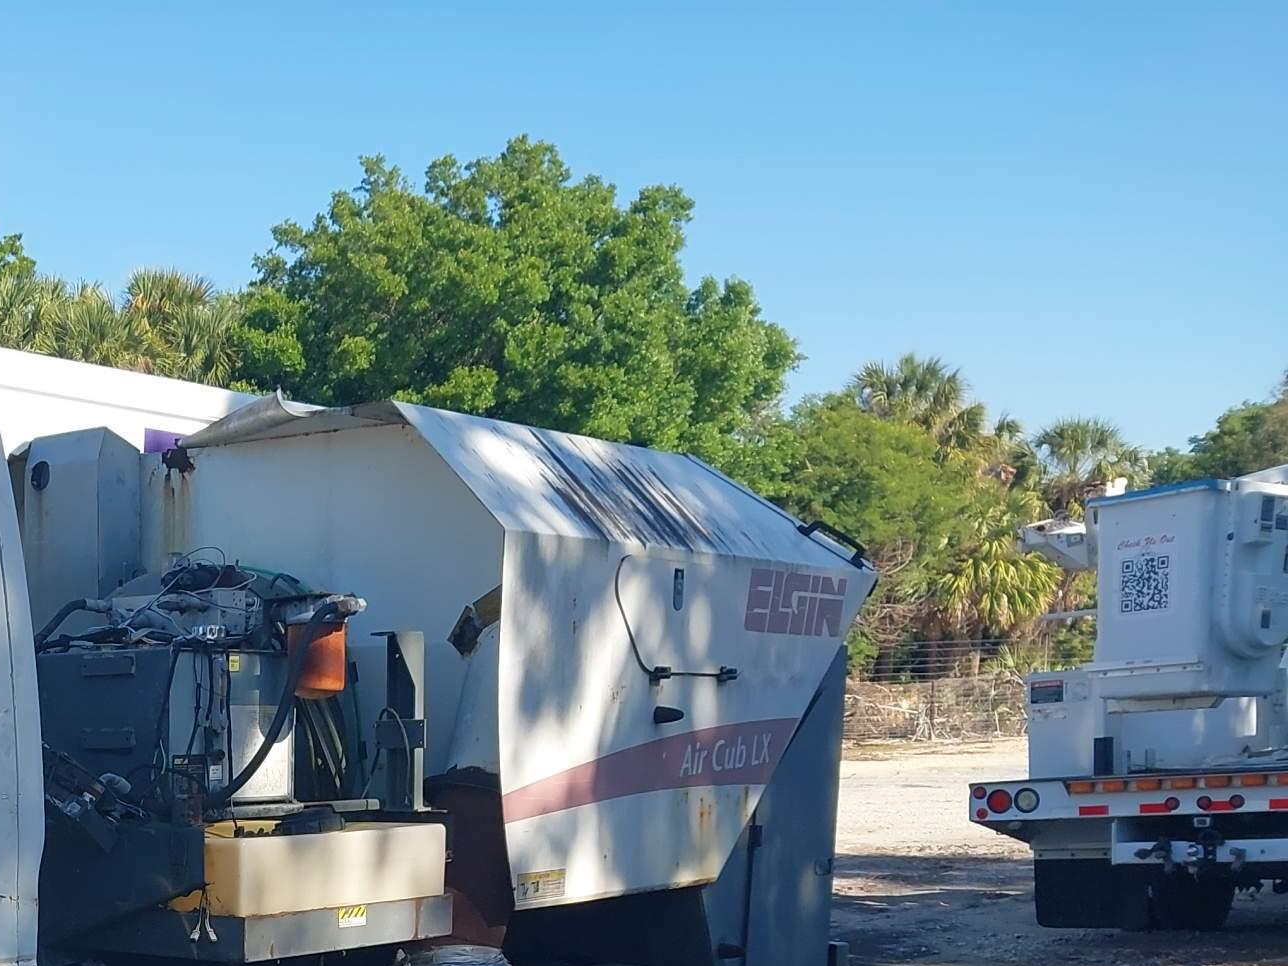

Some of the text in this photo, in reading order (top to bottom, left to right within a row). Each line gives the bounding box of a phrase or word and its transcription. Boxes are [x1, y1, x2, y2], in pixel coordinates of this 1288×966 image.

[744, 568, 847, 637] ELGIN
[680, 733, 772, 776] Air Cub LX
